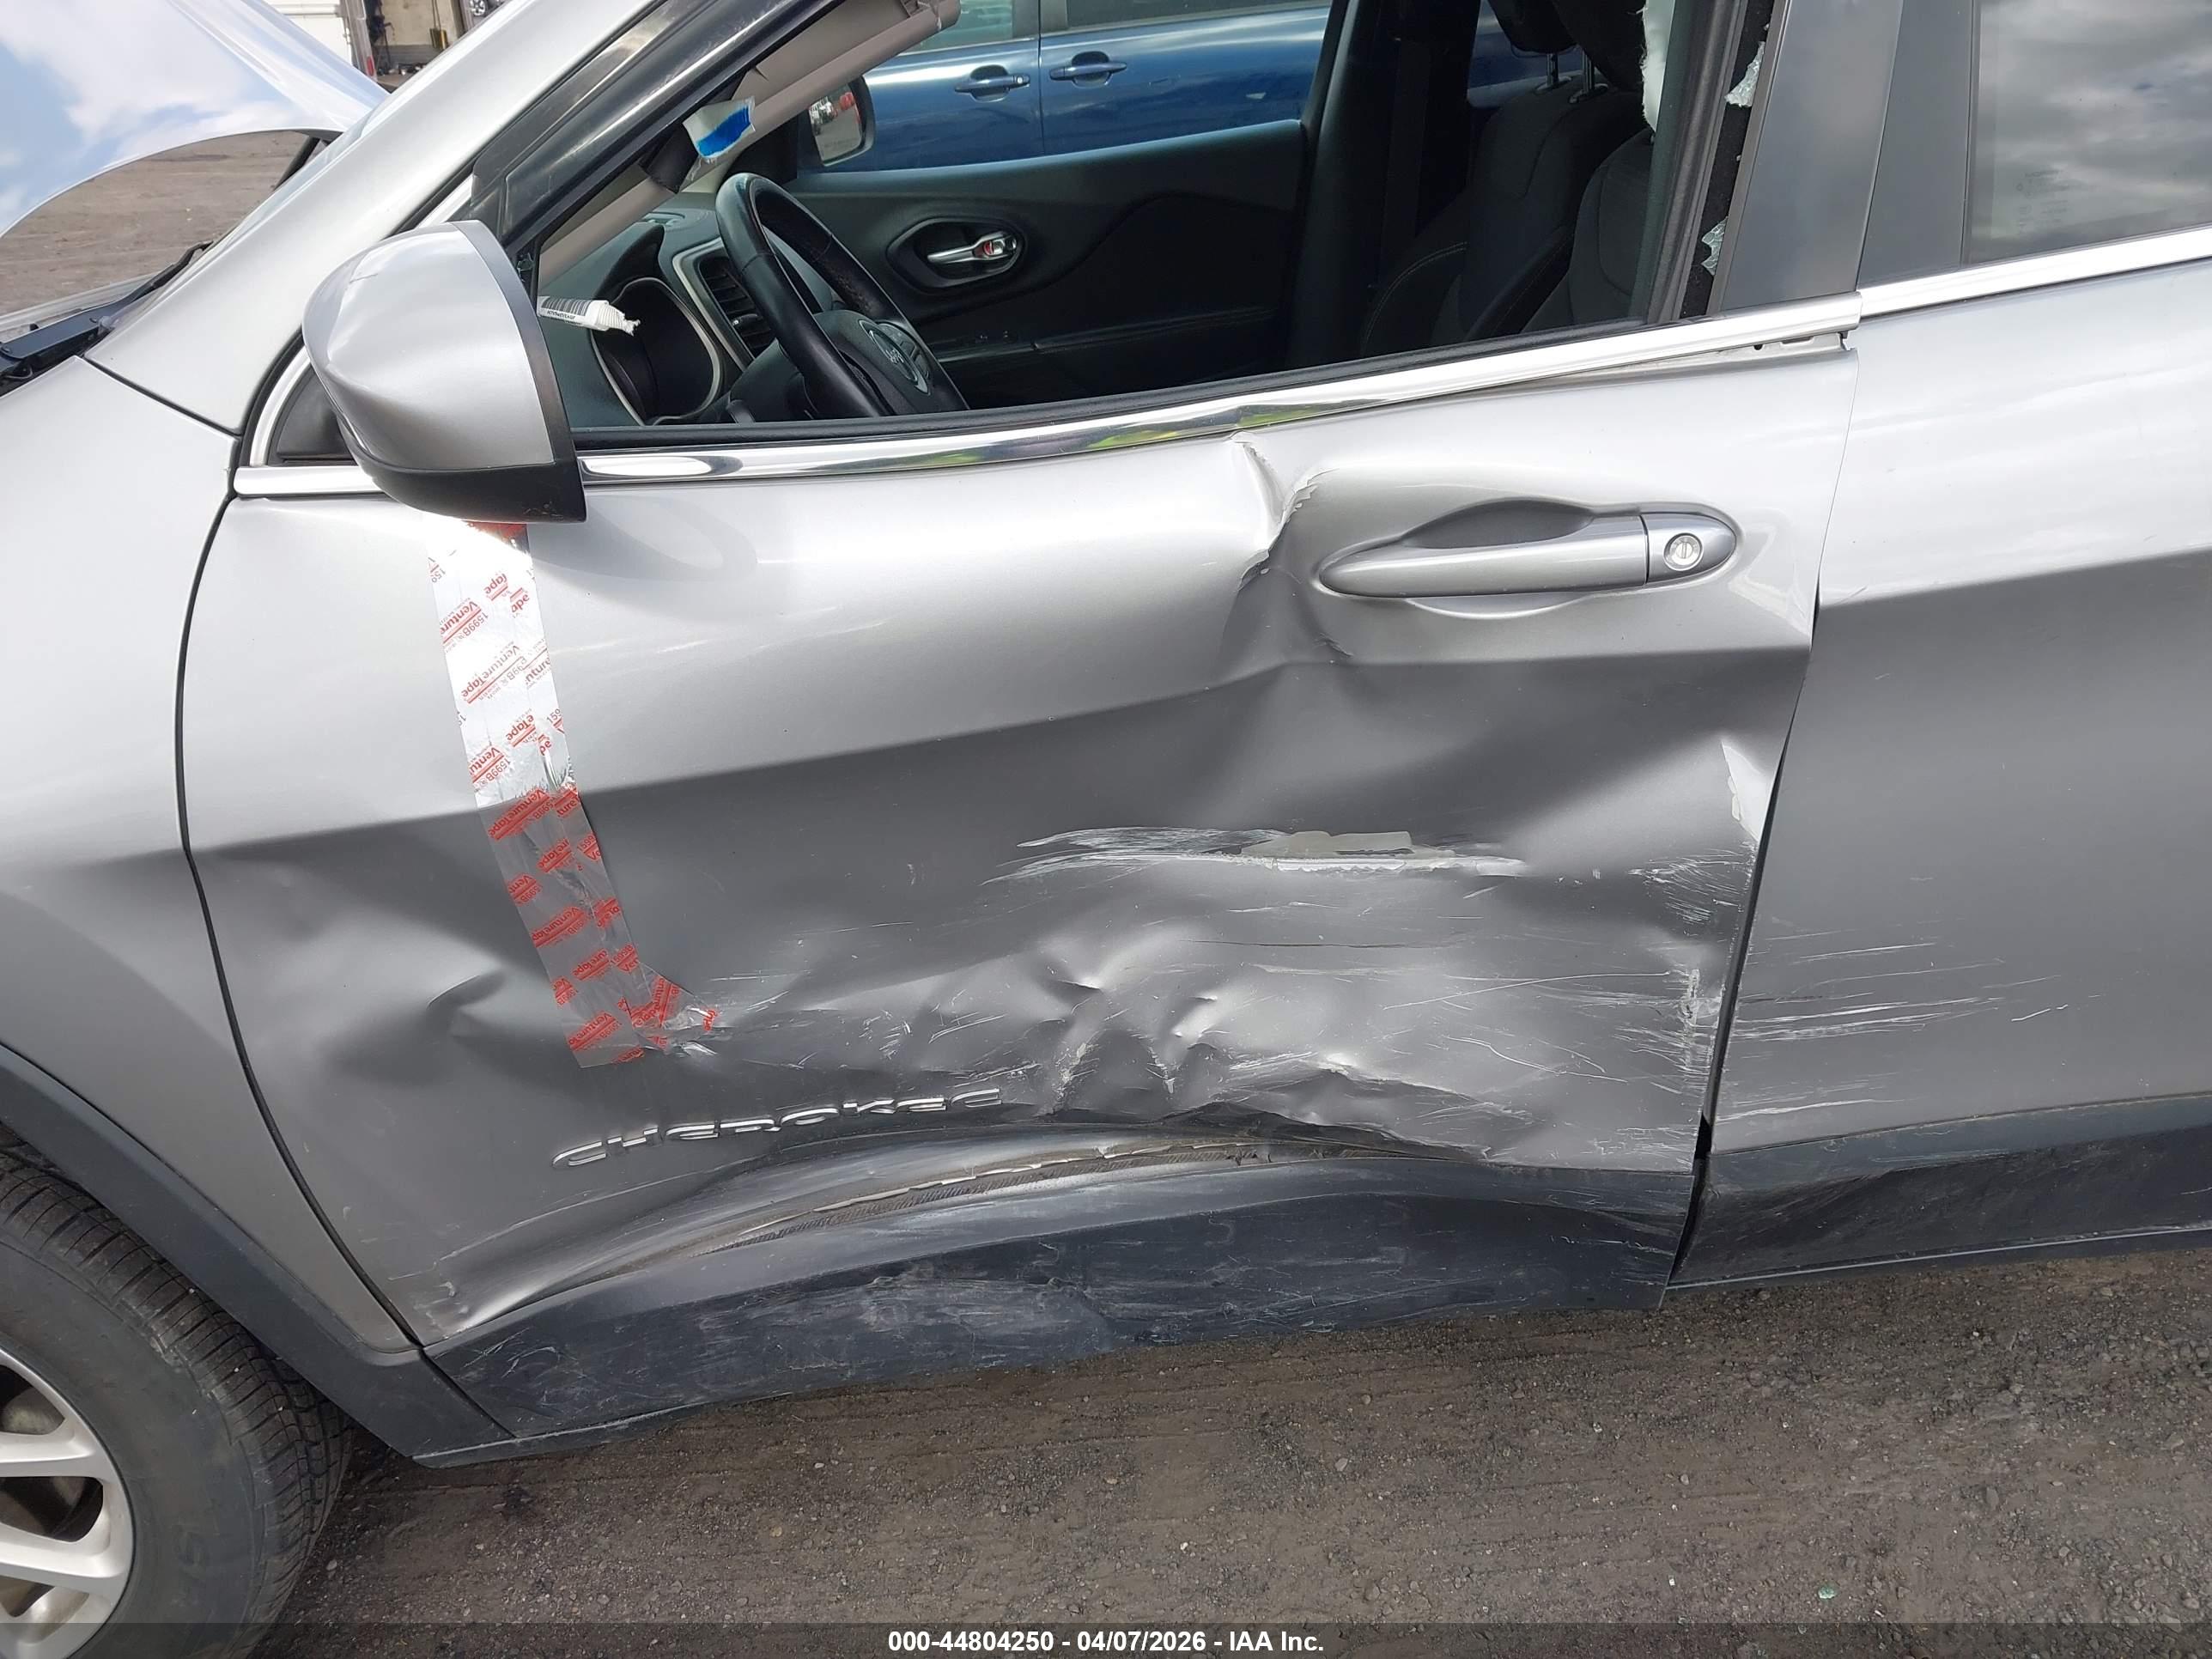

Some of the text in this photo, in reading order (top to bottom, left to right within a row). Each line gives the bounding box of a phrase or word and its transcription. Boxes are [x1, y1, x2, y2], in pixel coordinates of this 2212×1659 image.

[463, 611, 489, 636] 1599B
[461, 645, 520, 697] VentureTape
[485, 757, 512, 782] 1599B
[488, 788, 545, 836] VentureTape
[551, 1087, 1002, 1167] CHEROKEE
